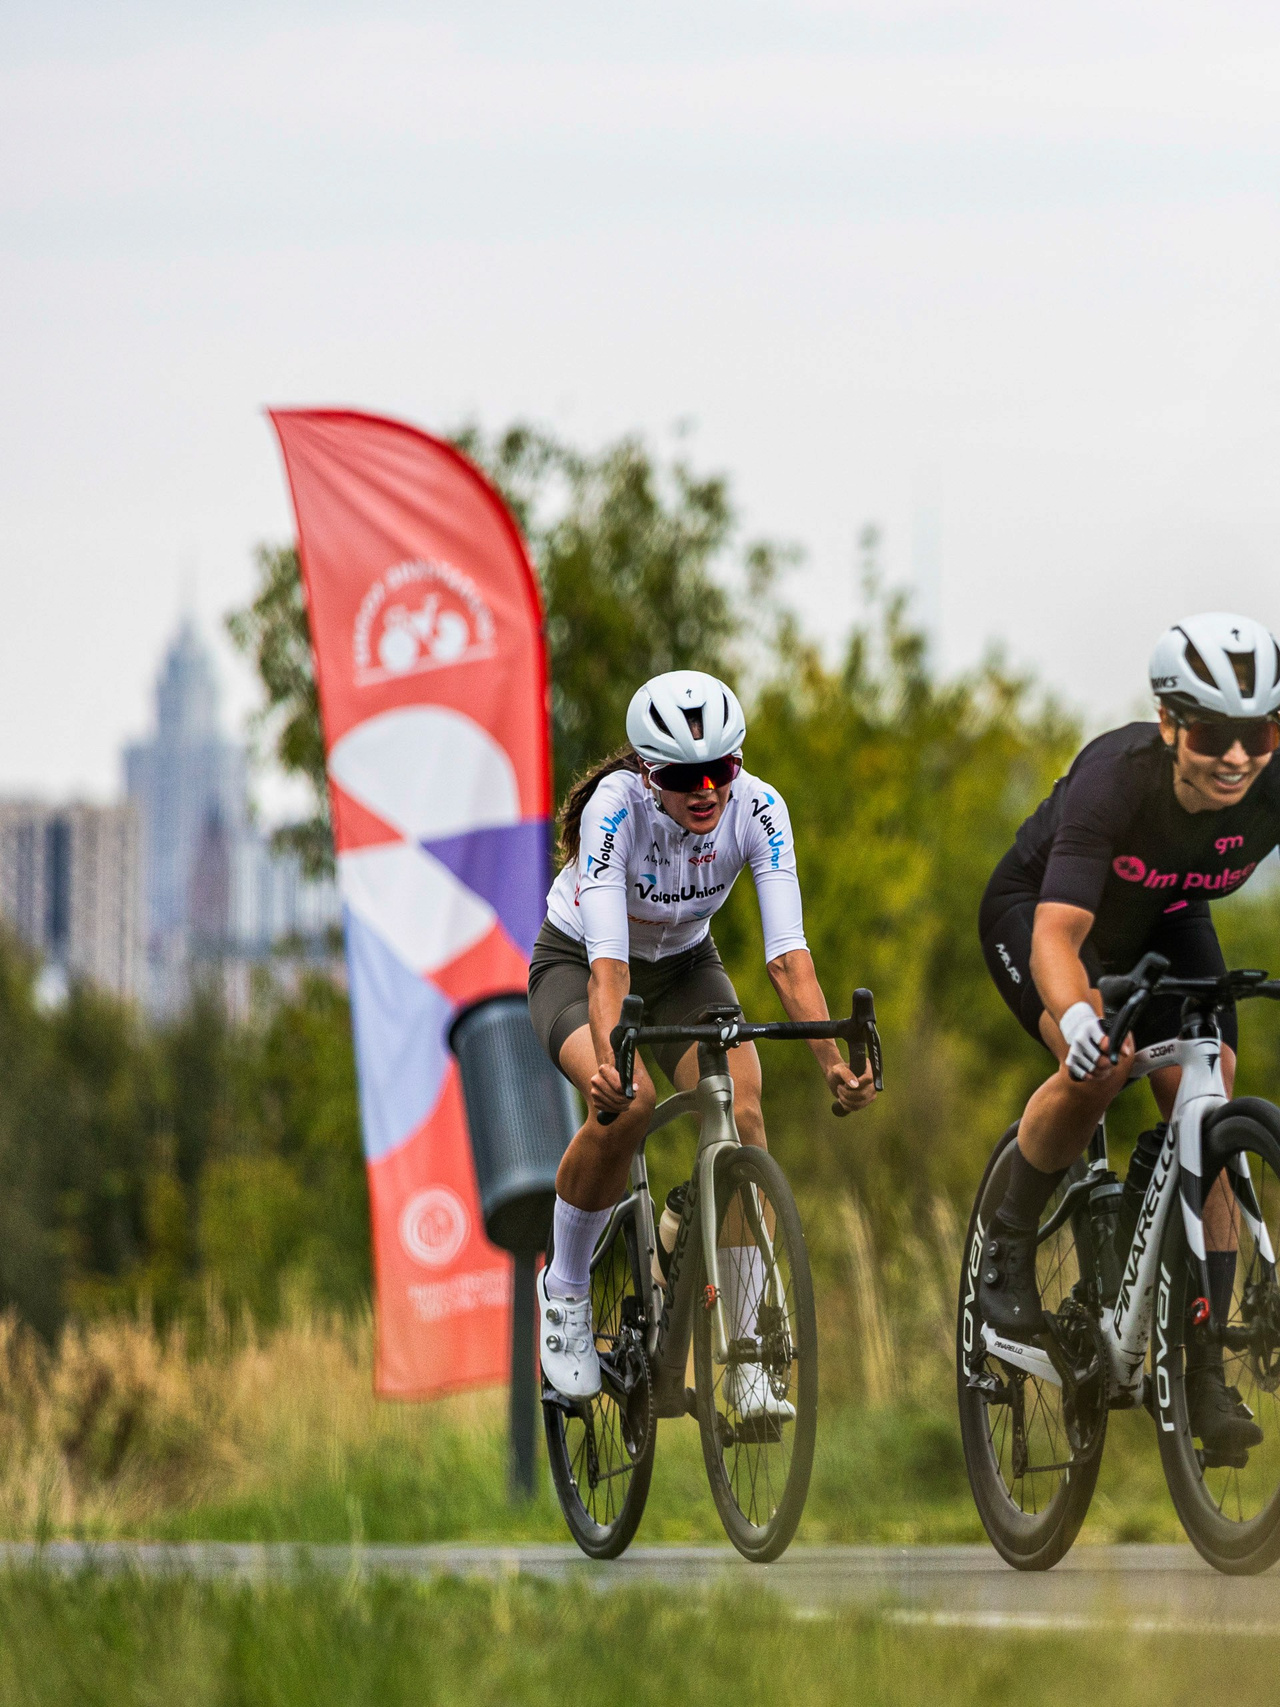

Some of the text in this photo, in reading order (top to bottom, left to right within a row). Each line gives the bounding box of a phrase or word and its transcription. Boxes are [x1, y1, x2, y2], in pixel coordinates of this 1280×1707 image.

[592, 808, 628, 879] VolgaUnion
[635, 882, 725, 904] VolgaUnion
[994, 1341, 1024, 1354] PINARELLO
[1156, 1261, 1175, 1432] roval
